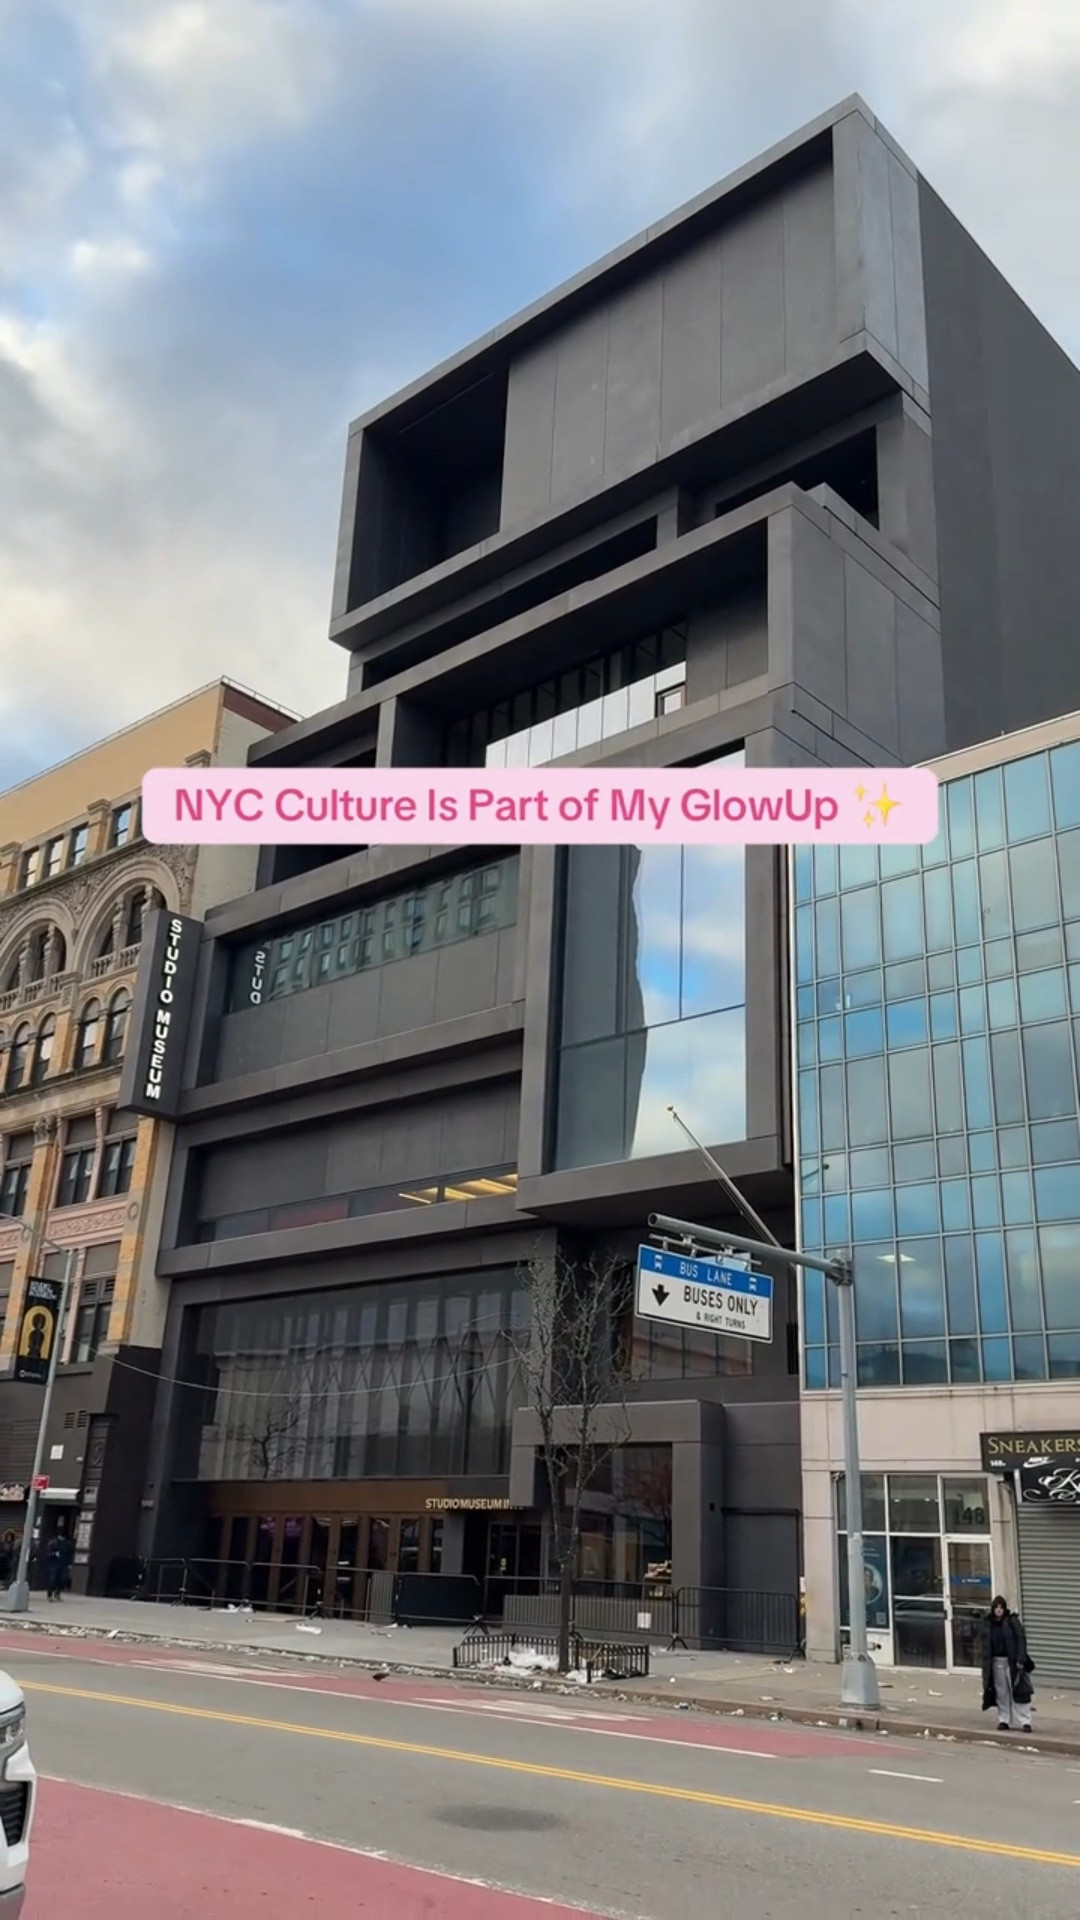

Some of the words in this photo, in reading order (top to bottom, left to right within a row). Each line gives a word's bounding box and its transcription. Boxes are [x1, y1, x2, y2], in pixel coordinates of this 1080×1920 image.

[160, 919, 183, 1004] STUDIO
[146, 1009, 171, 1099] MUSEUM
[680, 1262, 698, 1277] BUS
[707, 1268, 732, 1286] LANE
[684, 1286, 723, 1309] BUSES
[728, 1296, 758, 1316] ONLY
[704, 1313, 722, 1324] RIGHT
[725, 1317, 746, 1330] TURNS
[425, 1498, 459, 1509] STUDIO
[460, 1498, 502, 1510] MUSEUM
[955, 1507, 985, 1525] 148
